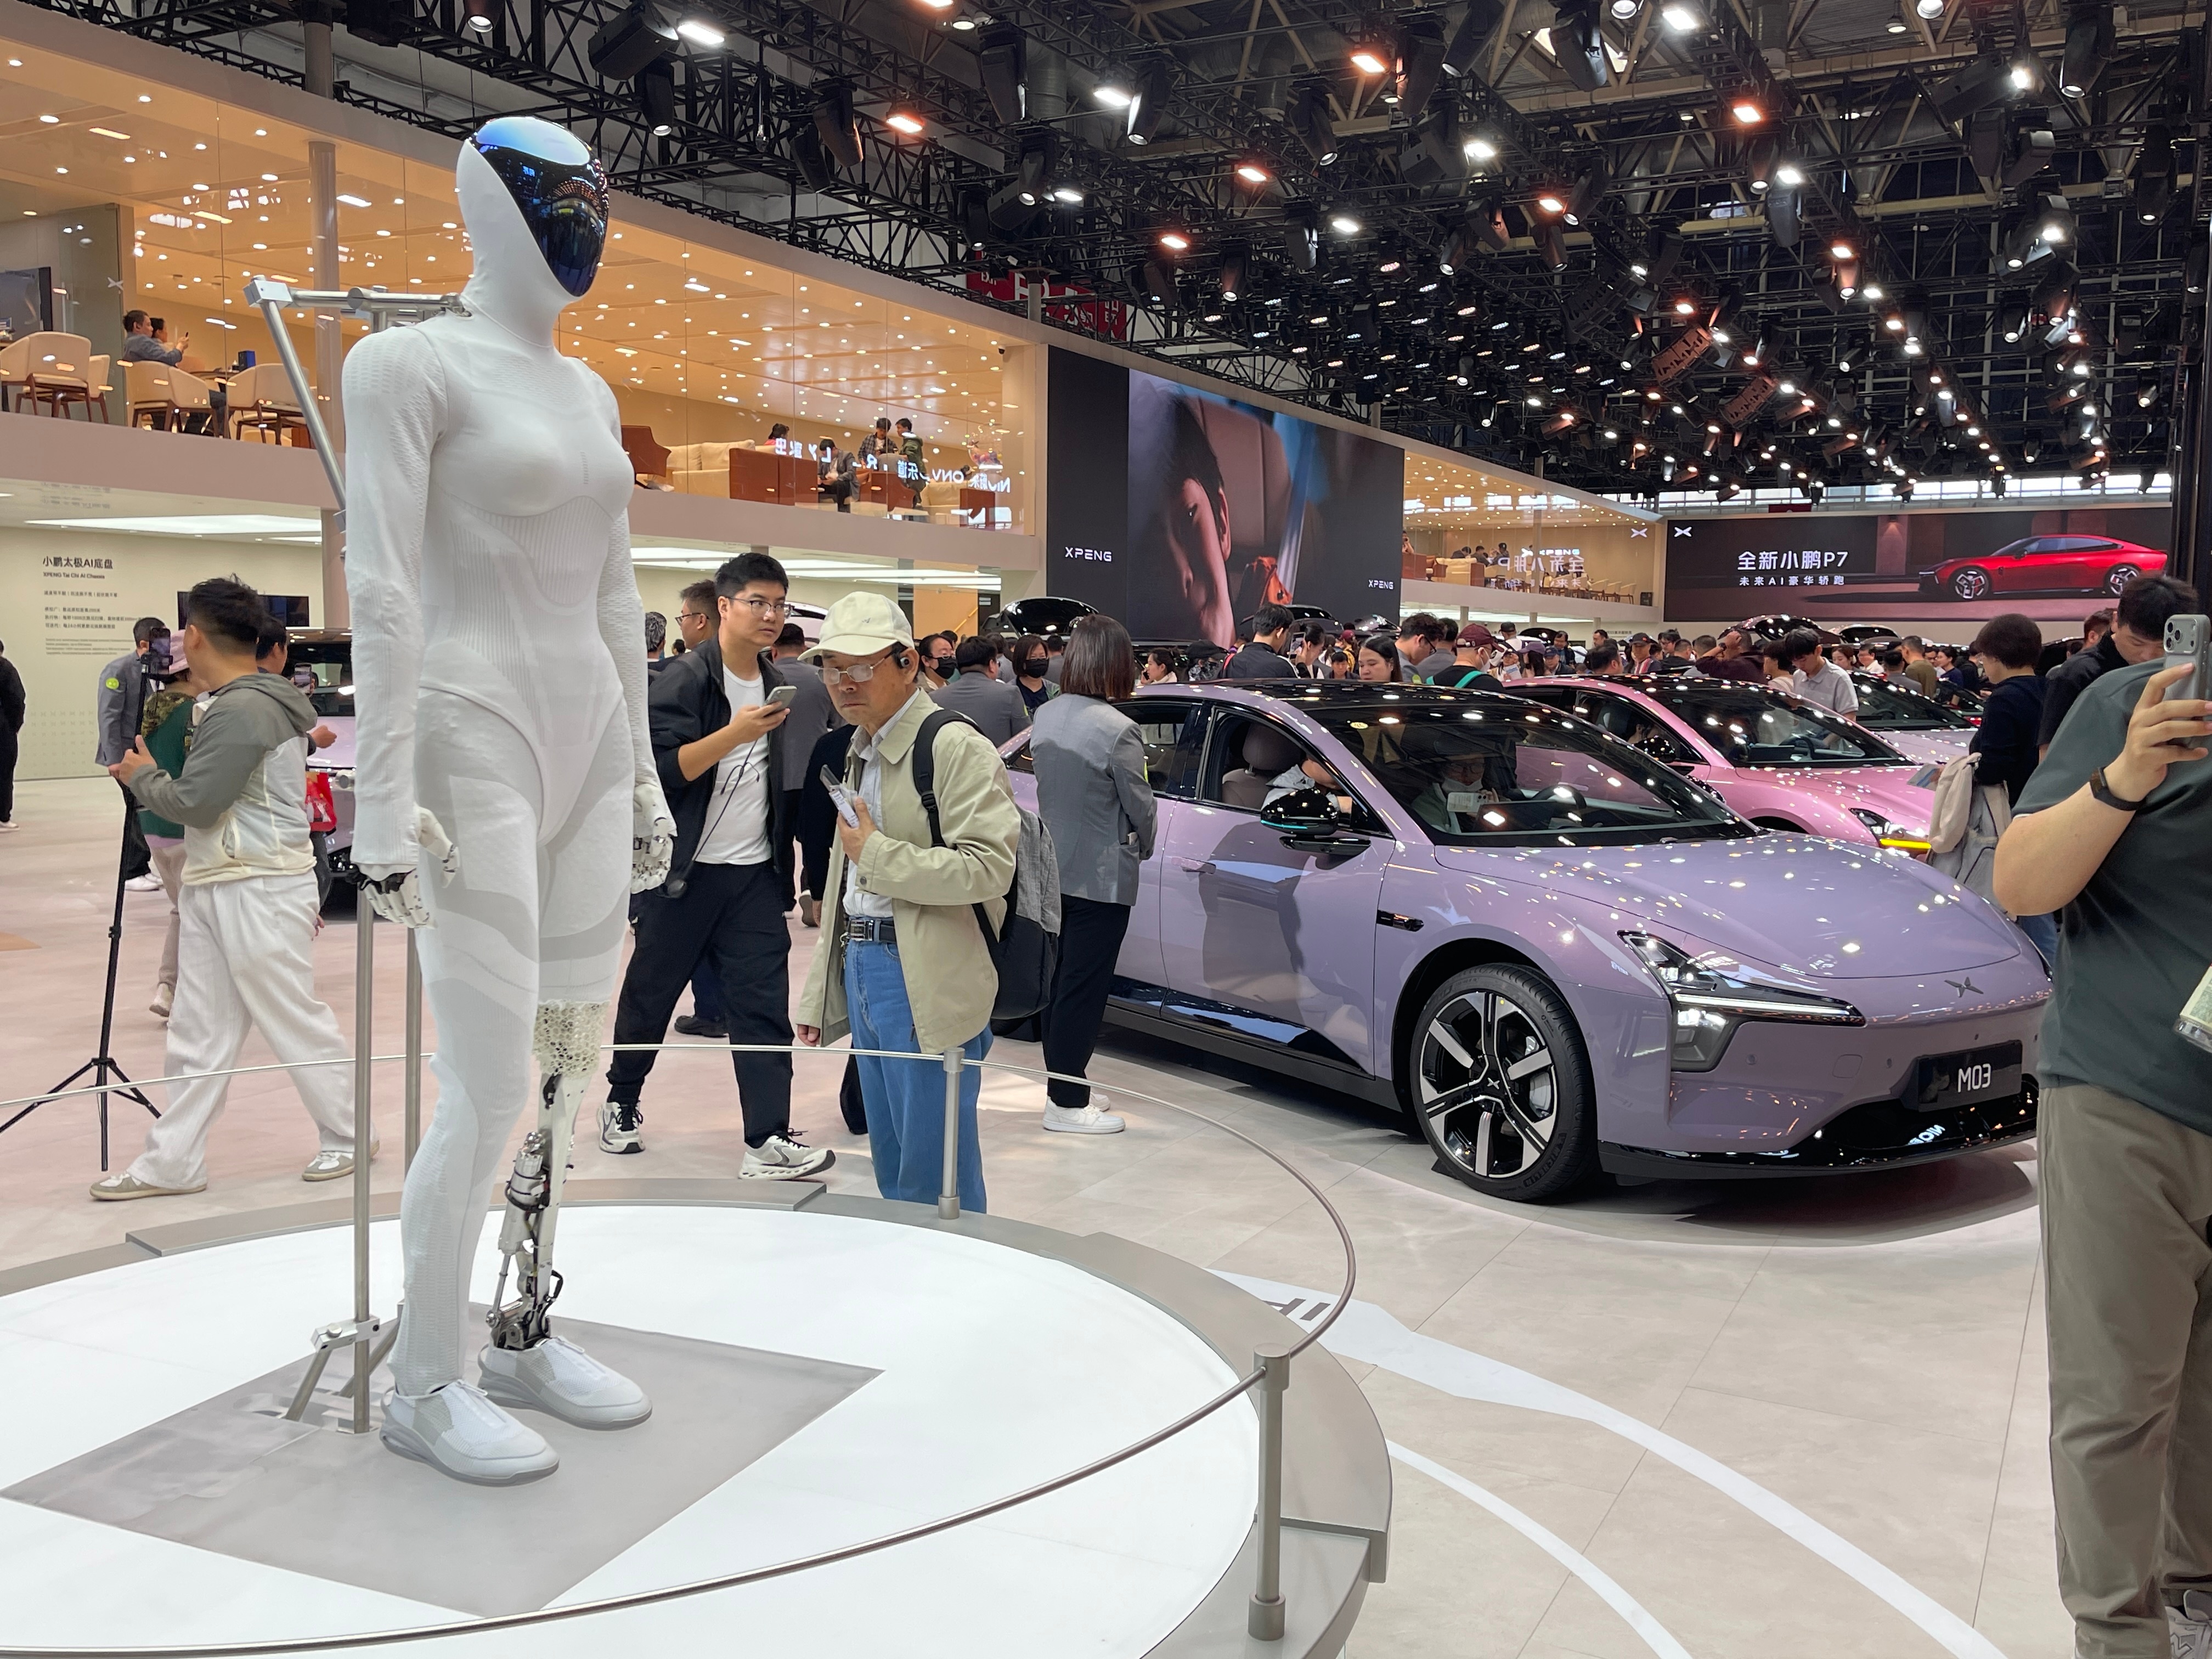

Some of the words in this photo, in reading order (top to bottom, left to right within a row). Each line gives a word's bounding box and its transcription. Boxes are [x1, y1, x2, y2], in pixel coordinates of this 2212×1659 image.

[1065, 546, 1112, 562] XPENG
[1737, 550, 1848, 571] 全新小鹏P7
[43, 556, 113, 569] 小鹏太极AI底盘
[1368, 579, 1393, 590] XPENG
[1739, 575, 1844, 586] 未来AI豪华轿跑
[1958, 1063, 1991, 1093] M03
